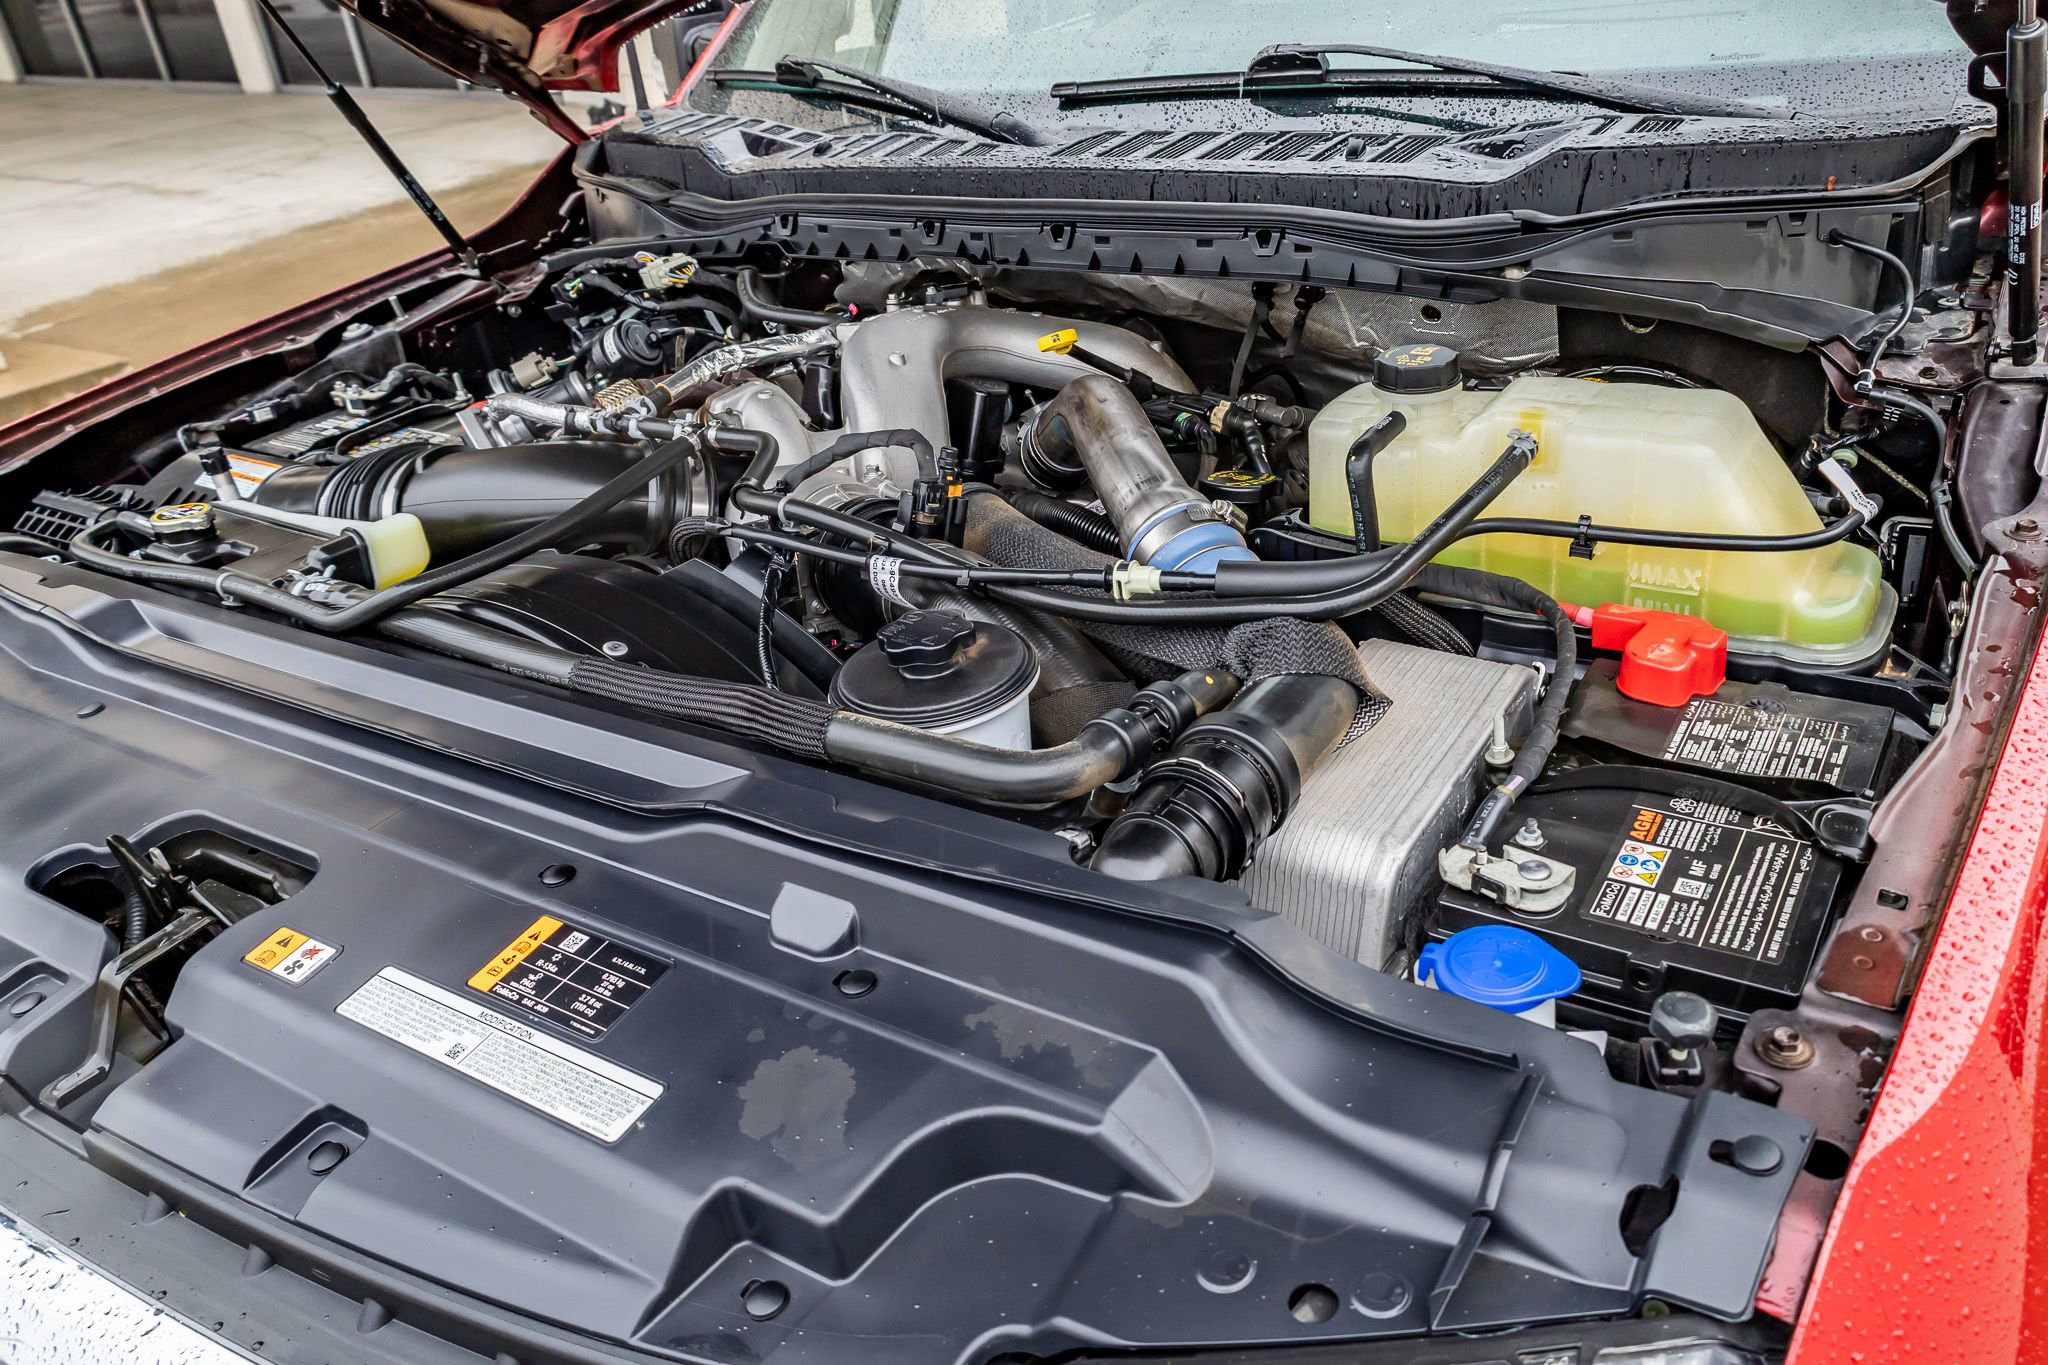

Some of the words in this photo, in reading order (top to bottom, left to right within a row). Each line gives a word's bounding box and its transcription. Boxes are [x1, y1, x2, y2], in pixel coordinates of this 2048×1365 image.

[1641, 562, 1702, 591] MAX
[1630, 810, 1656, 841] AGM
[1688, 860, 1707, 876] MF
[1596, 883, 1620, 915] FoMoCo
[535, 959, 559, 972] R-134a
[519, 977, 536, 988] PAG
[492, 985, 520, 1000] FoMoCo
[522, 998, 536, 1007] SAE
[478, 1011, 535, 1040] MODIFICATION
